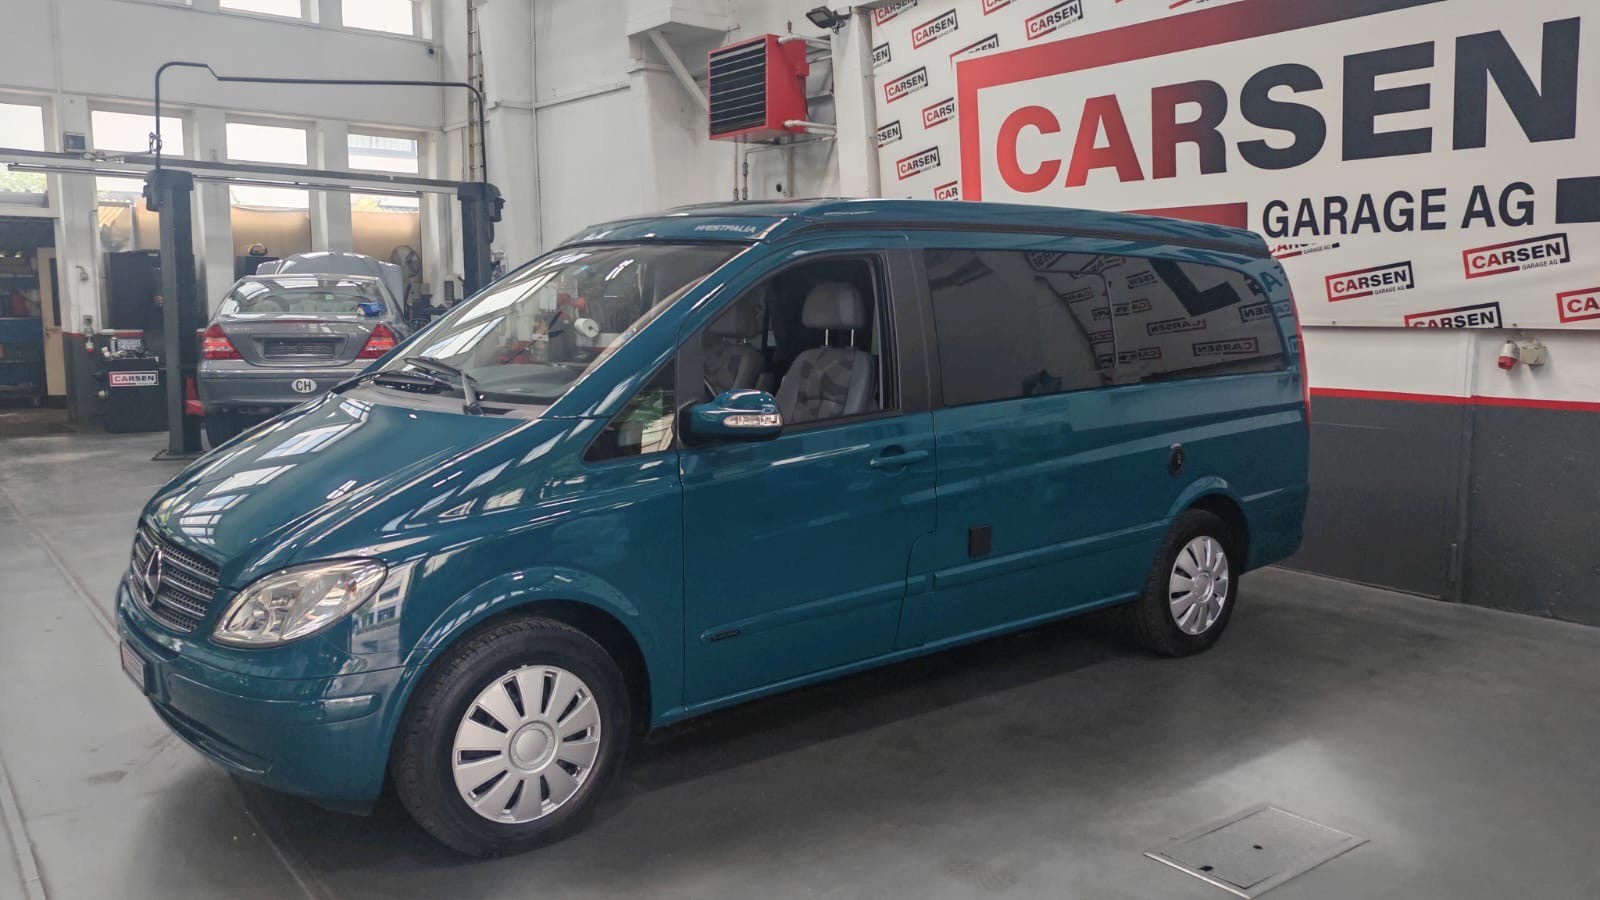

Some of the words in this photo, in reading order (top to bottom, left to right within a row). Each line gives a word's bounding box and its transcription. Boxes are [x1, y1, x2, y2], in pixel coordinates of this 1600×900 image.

[916, 16, 954, 42] CARSEN
[1030, 3, 1078, 33] CARSEN
[888, 72, 925, 97] CARSEN
[997, 16, 1580, 193] CARSEN
[900, 152, 937, 174] CARSEN
[1262, 187, 1447, 238] GARAGE
[1461, 181, 1535, 229] AG
[1471, 242, 1561, 269] CARSEN
[1522, 261, 1548, 271] GARAGE
[1333, 269, 1407, 293] CARSEN
[1374, 286, 1396, 295] GARAGE
[295, 381, 312, 392] CH
